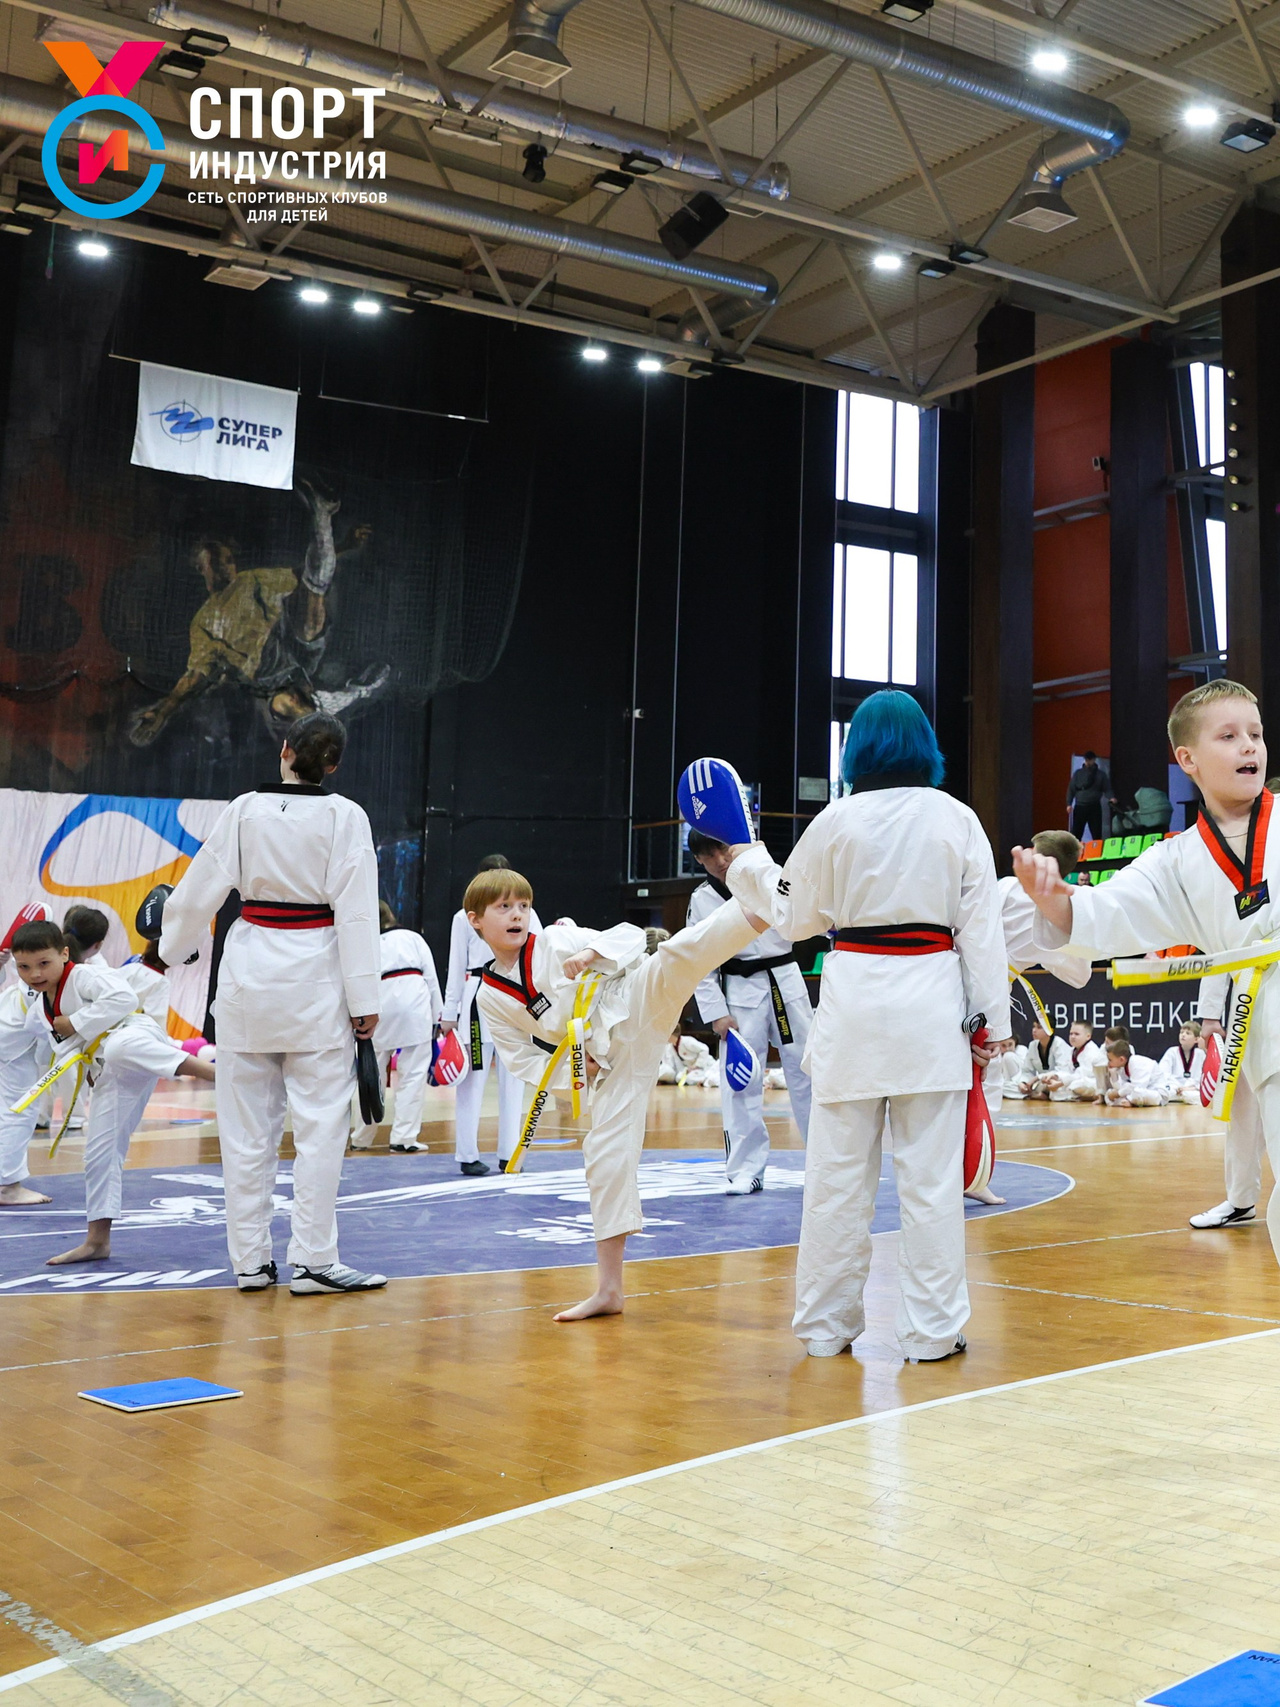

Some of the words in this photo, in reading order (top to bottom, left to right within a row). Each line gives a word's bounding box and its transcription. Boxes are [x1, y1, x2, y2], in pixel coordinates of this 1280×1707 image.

[216, 431, 270, 452] ЛИГА
[218, 417, 283, 439] СУПЕР
[1221, 993, 1253, 1084] TAEKWONDO
[572, 1043, 585, 1078] PRIDE
